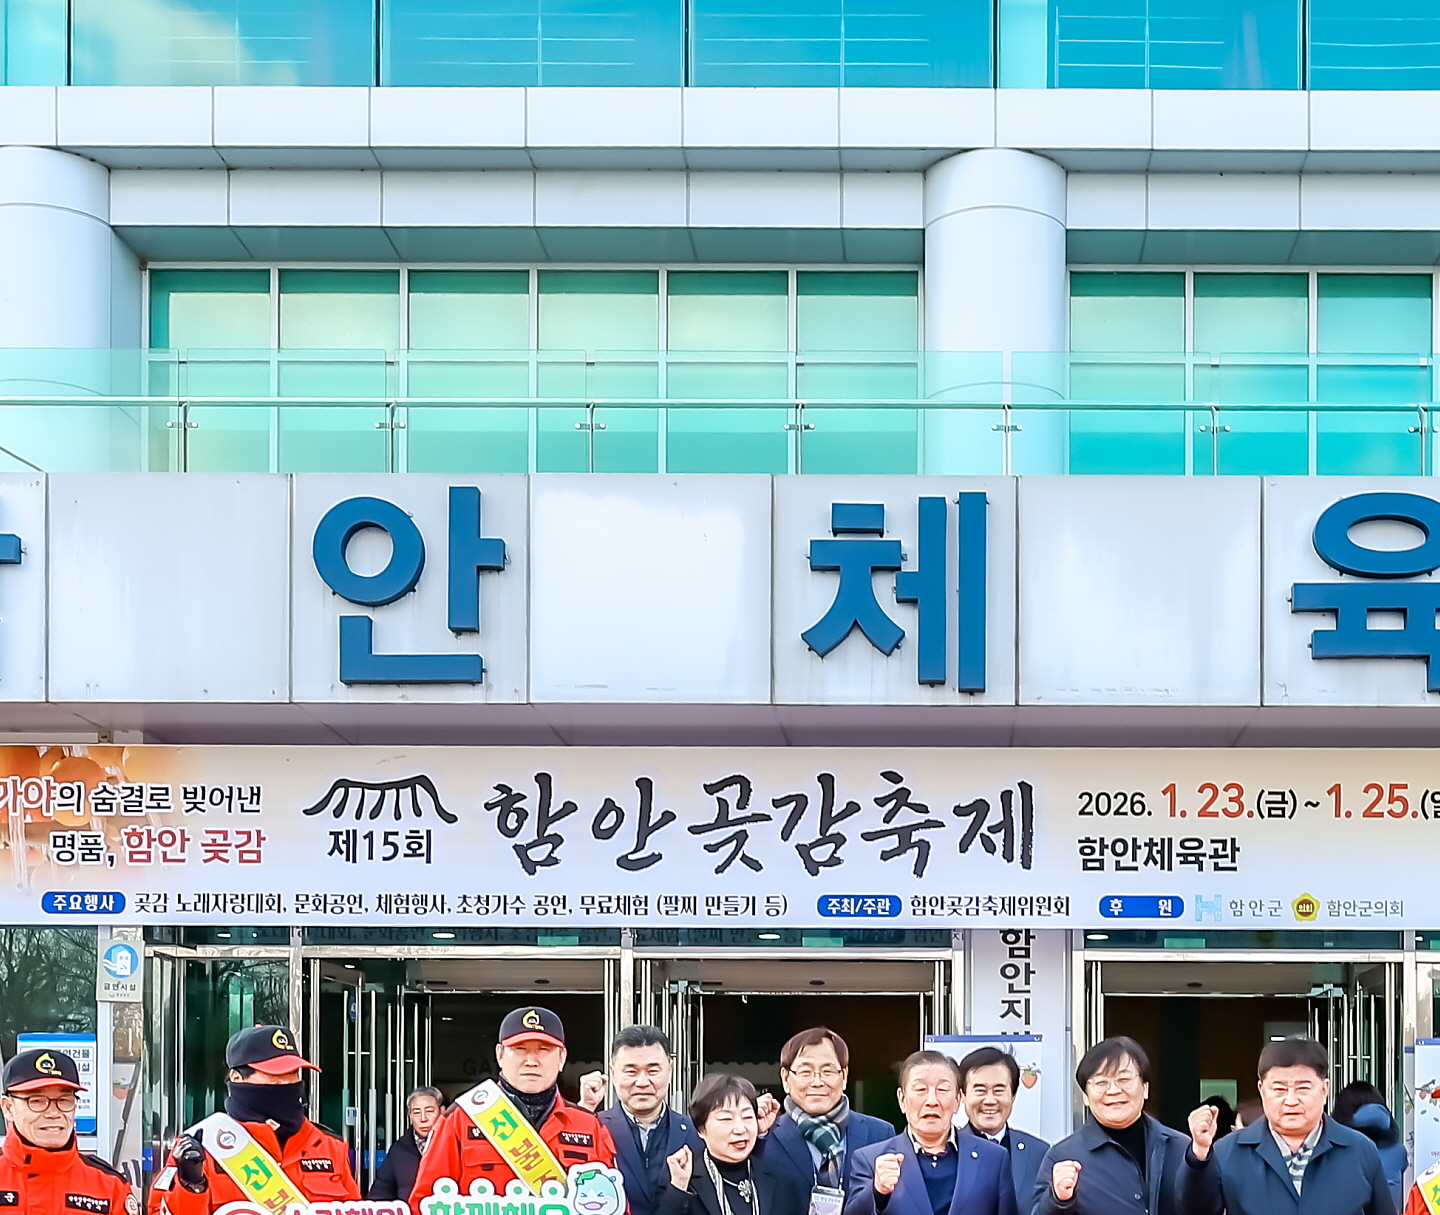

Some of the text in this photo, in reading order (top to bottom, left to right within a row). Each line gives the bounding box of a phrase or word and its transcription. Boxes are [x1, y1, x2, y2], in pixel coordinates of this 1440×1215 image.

[89, 782, 173, 814] 숨결로
[182, 782, 262, 814] 빚어낸
[1077, 791, 1153, 817] 2026.
[1161, 782, 1187, 819] 1.
[1196, 782, 1298, 821] 23.(금)
[483, 770, 1036, 880] 함안곶감축제
[51, 829, 267, 866] 명품, 함안 곶감
[327, 829, 433, 864] 제15회
[1077, 836, 1241, 873] 함안체육관
[53, 893, 115, 912] 주요행사
[133, 892, 788, 917] 곶감 노래자랑대회, 문화공연, 체험행사, 초청가수 공연, 무료체험 (팔찌 만들기 등)
[827, 897, 891, 915] 주최/주관
[910, 895, 1070, 917] 함안곶감축제위원회
[1229, 900, 1283, 918] 함안군
[1326, 900, 1404, 918] 함안군의회
[999, 929, 1036, 1035] 함안지
